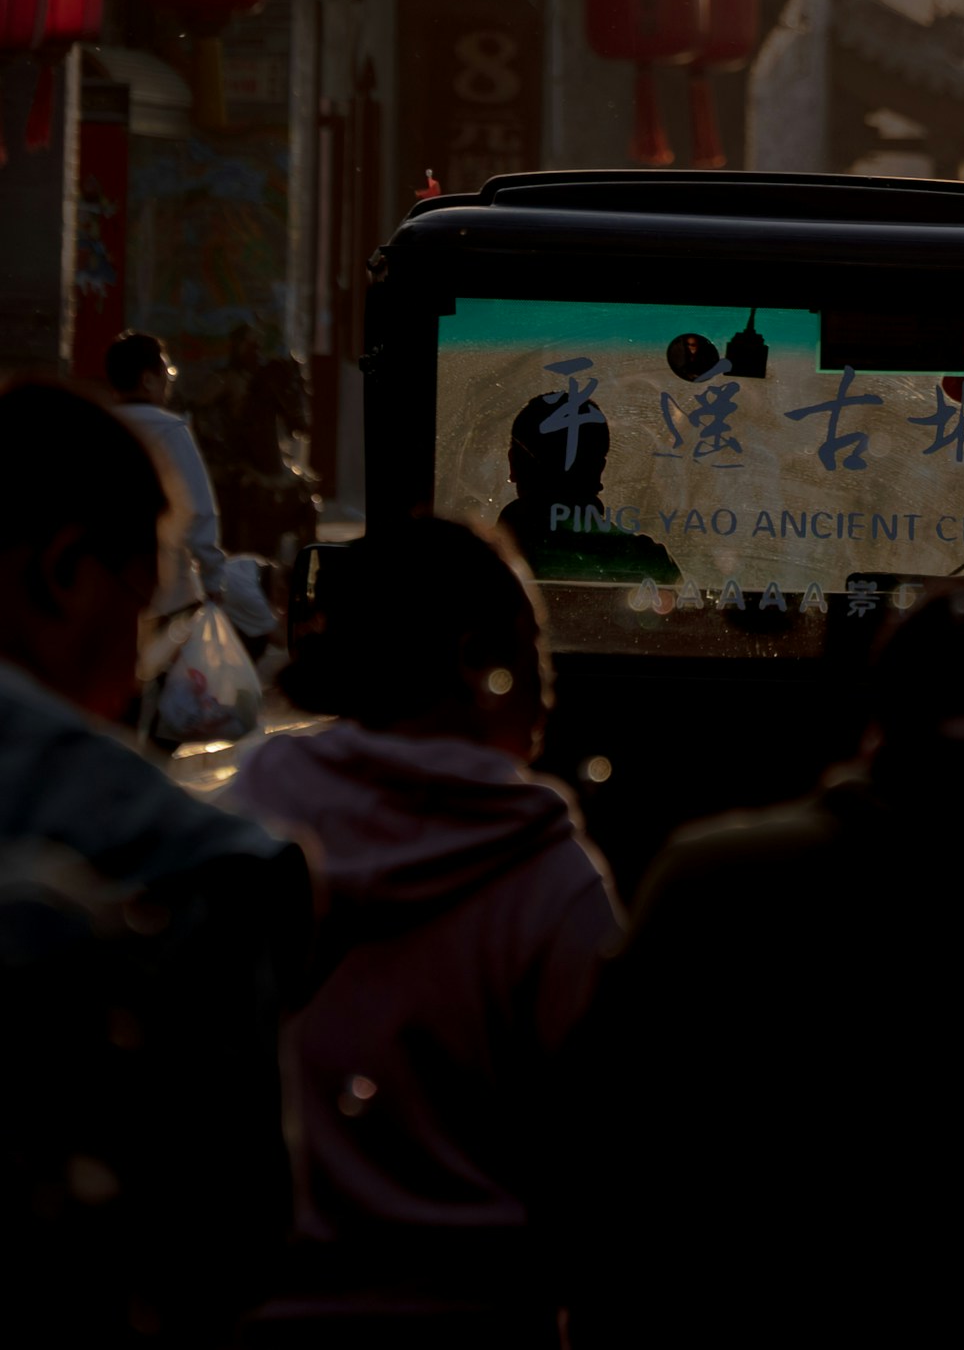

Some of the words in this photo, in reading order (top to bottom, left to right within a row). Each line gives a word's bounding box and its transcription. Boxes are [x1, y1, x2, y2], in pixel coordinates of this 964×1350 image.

[550, 502, 641, 534] PING
[658, 508, 738, 536] YAO
[752, 510, 922, 541] ANCIENT
